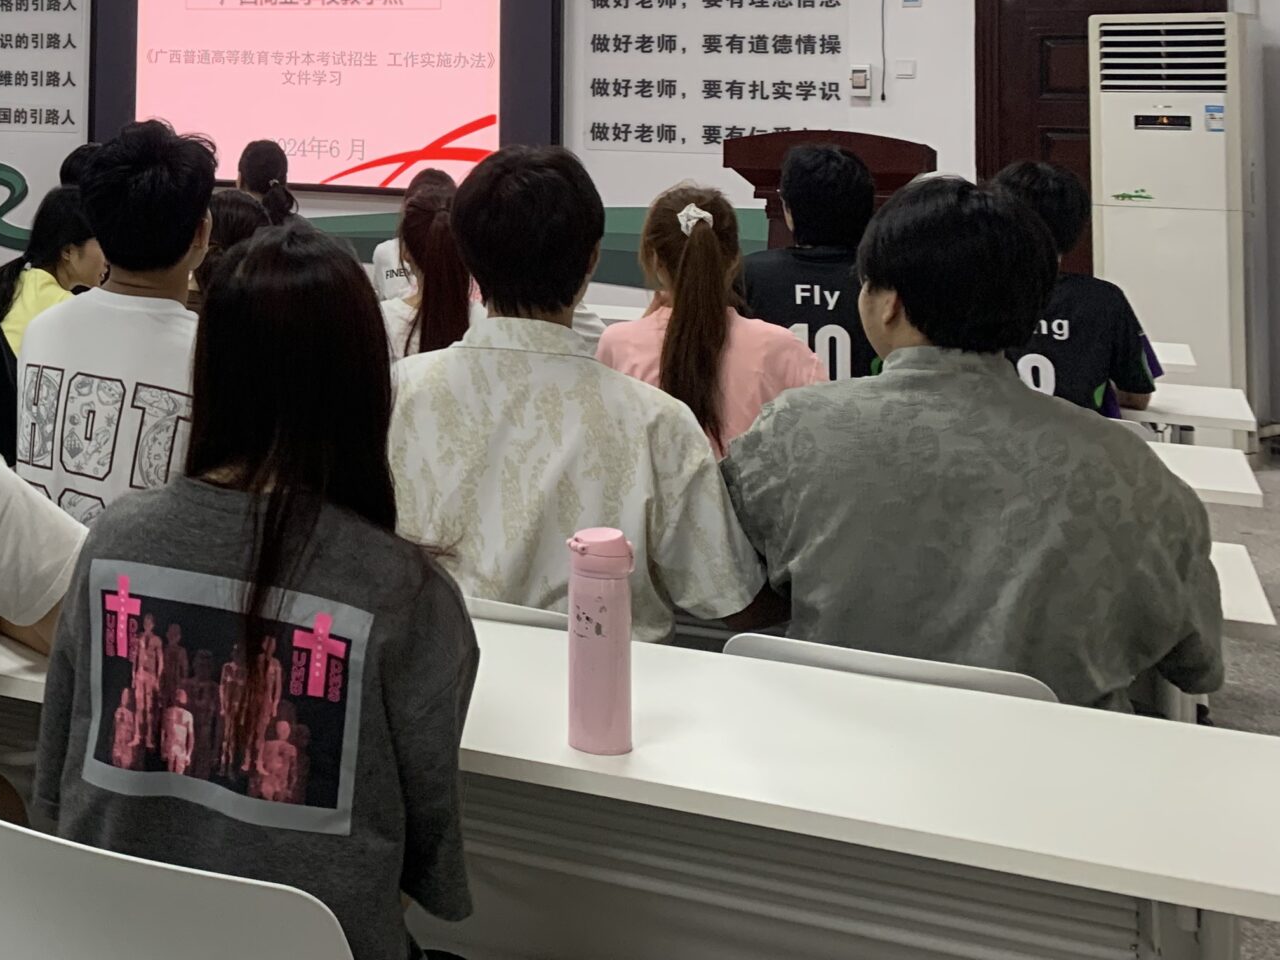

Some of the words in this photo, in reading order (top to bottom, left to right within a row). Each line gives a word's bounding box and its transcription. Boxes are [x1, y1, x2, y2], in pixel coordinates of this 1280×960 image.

[590, 33, 842, 55] 做好老师，要有道德情操
[282, 70, 342, 86] 文件学习
[590, 78, 842, 102] 做好老师，要有扎实学识
[794, 284, 841, 310] Fly
